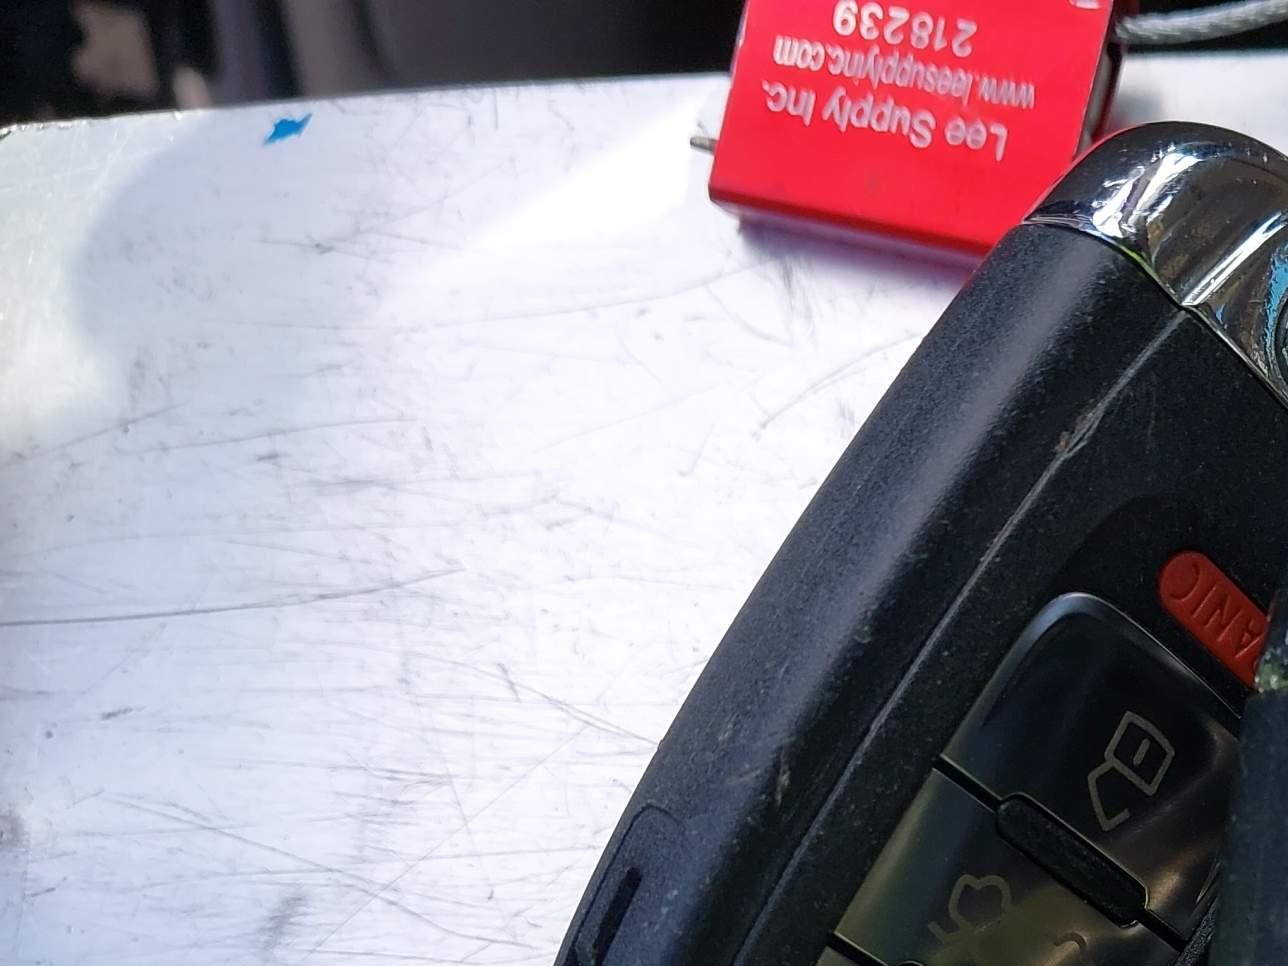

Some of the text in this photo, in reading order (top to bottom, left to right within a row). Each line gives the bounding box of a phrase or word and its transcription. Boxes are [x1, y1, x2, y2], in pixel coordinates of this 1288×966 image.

[832, 0, 978, 58] 218239
[772, 34, 1036, 110] www.leesupplyinc.com
[761, 79, 1008, 161] Lee Supply Inc.
[1168, 558, 1266, 662] ANIC
